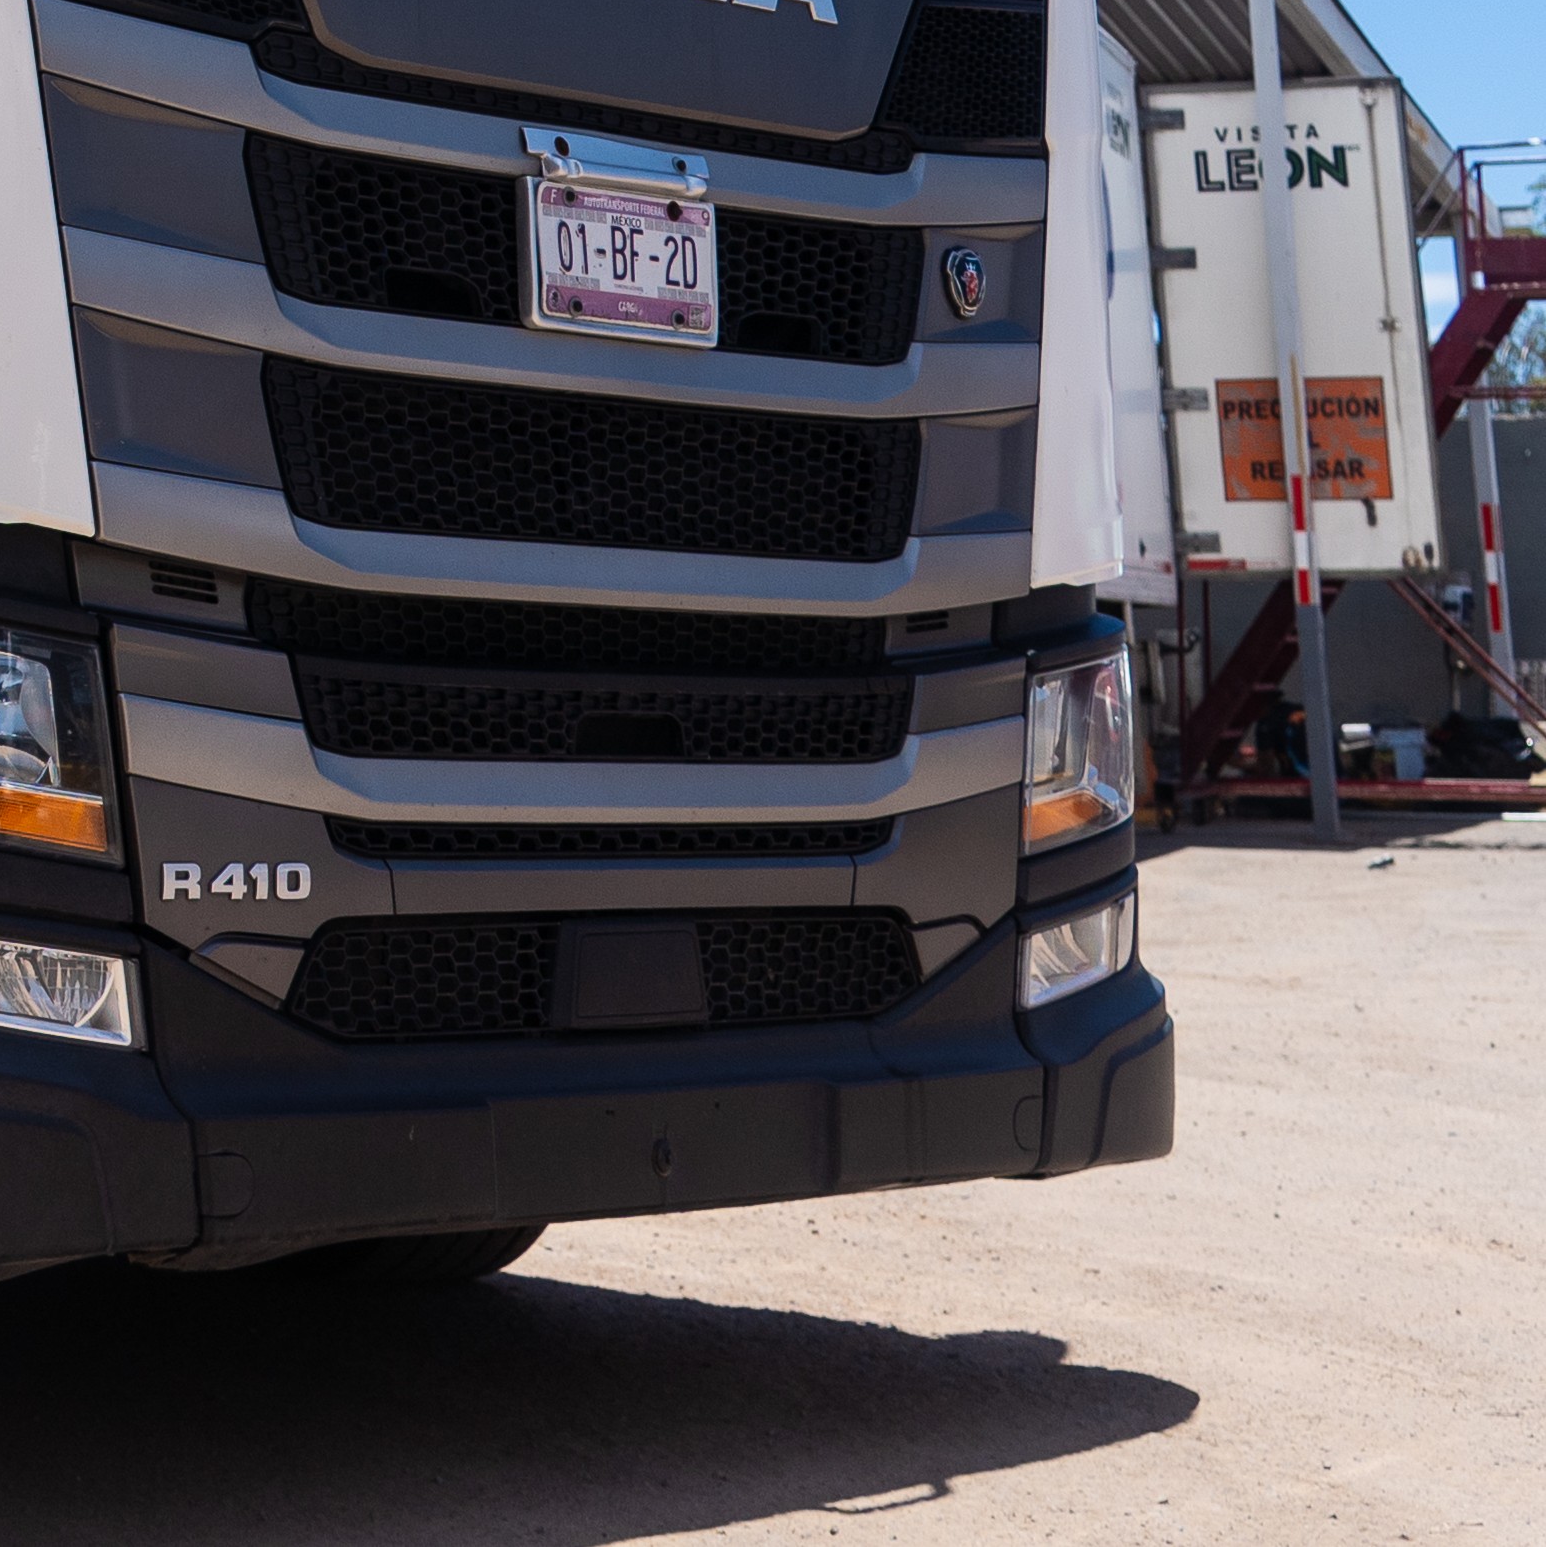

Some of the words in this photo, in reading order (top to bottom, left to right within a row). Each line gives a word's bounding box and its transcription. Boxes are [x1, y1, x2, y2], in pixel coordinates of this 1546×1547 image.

[1214, 123, 1320, 142] VISTA
[611, 214, 642, 228] MÉXICO
[640, 204, 665, 217] FEDERAL
[557, 220, 698, 290] 01-BF-2D
[1223, 392, 1381, 420] PRECUCIÓN
[1251, 456, 1366, 482] RESAR
